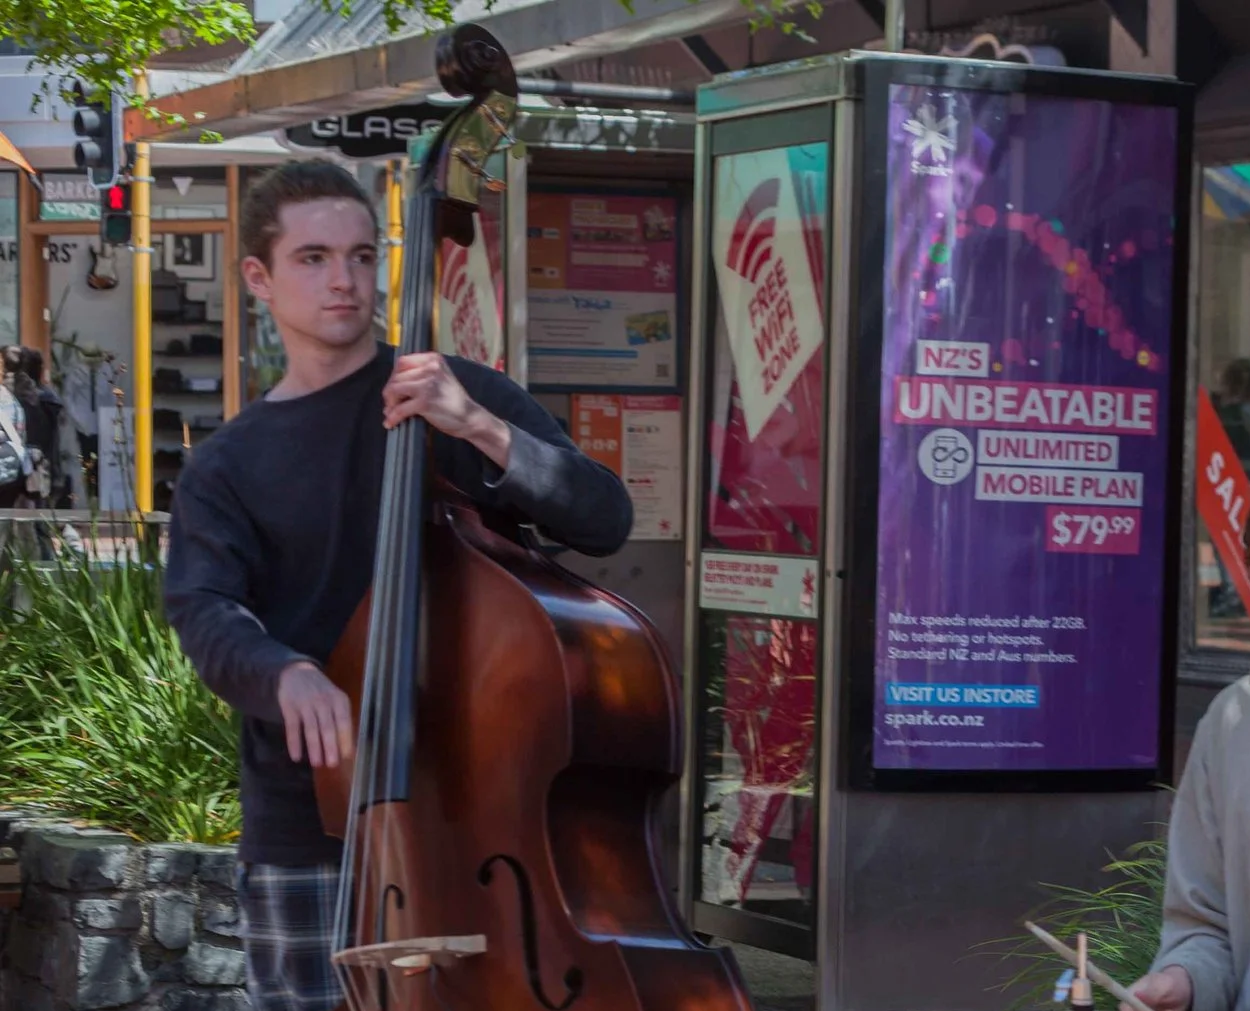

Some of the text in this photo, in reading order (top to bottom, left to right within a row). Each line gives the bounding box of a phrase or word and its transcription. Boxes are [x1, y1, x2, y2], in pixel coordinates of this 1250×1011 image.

[748, 256, 787, 329] FREE
[762, 326, 801, 395] ZONE
[924, 346, 982, 370] NZ'S
[900, 381, 1152, 430] UNBEATABLE
[984, 436, 1113, 463] UNLIMITED
[982, 472, 1137, 499] MOBILE PLAN
[1205, 451, 1247, 549] SAL
[1052, 511, 1136, 547] $79.99
[888, 612, 917, 625] Max
[919, 613, 966, 628] speeds
[968, 614, 1020, 628] reduced
[1021, 615, 1050, 628] after
[888, 630, 1044, 647] No tethering or hotspots.
[888, 647, 1078, 663] Standard NZ and Aus numbers.
[890, 685, 1036, 704] VISIT US INSTORE
[884, 710, 985, 729] spark.co.nz
